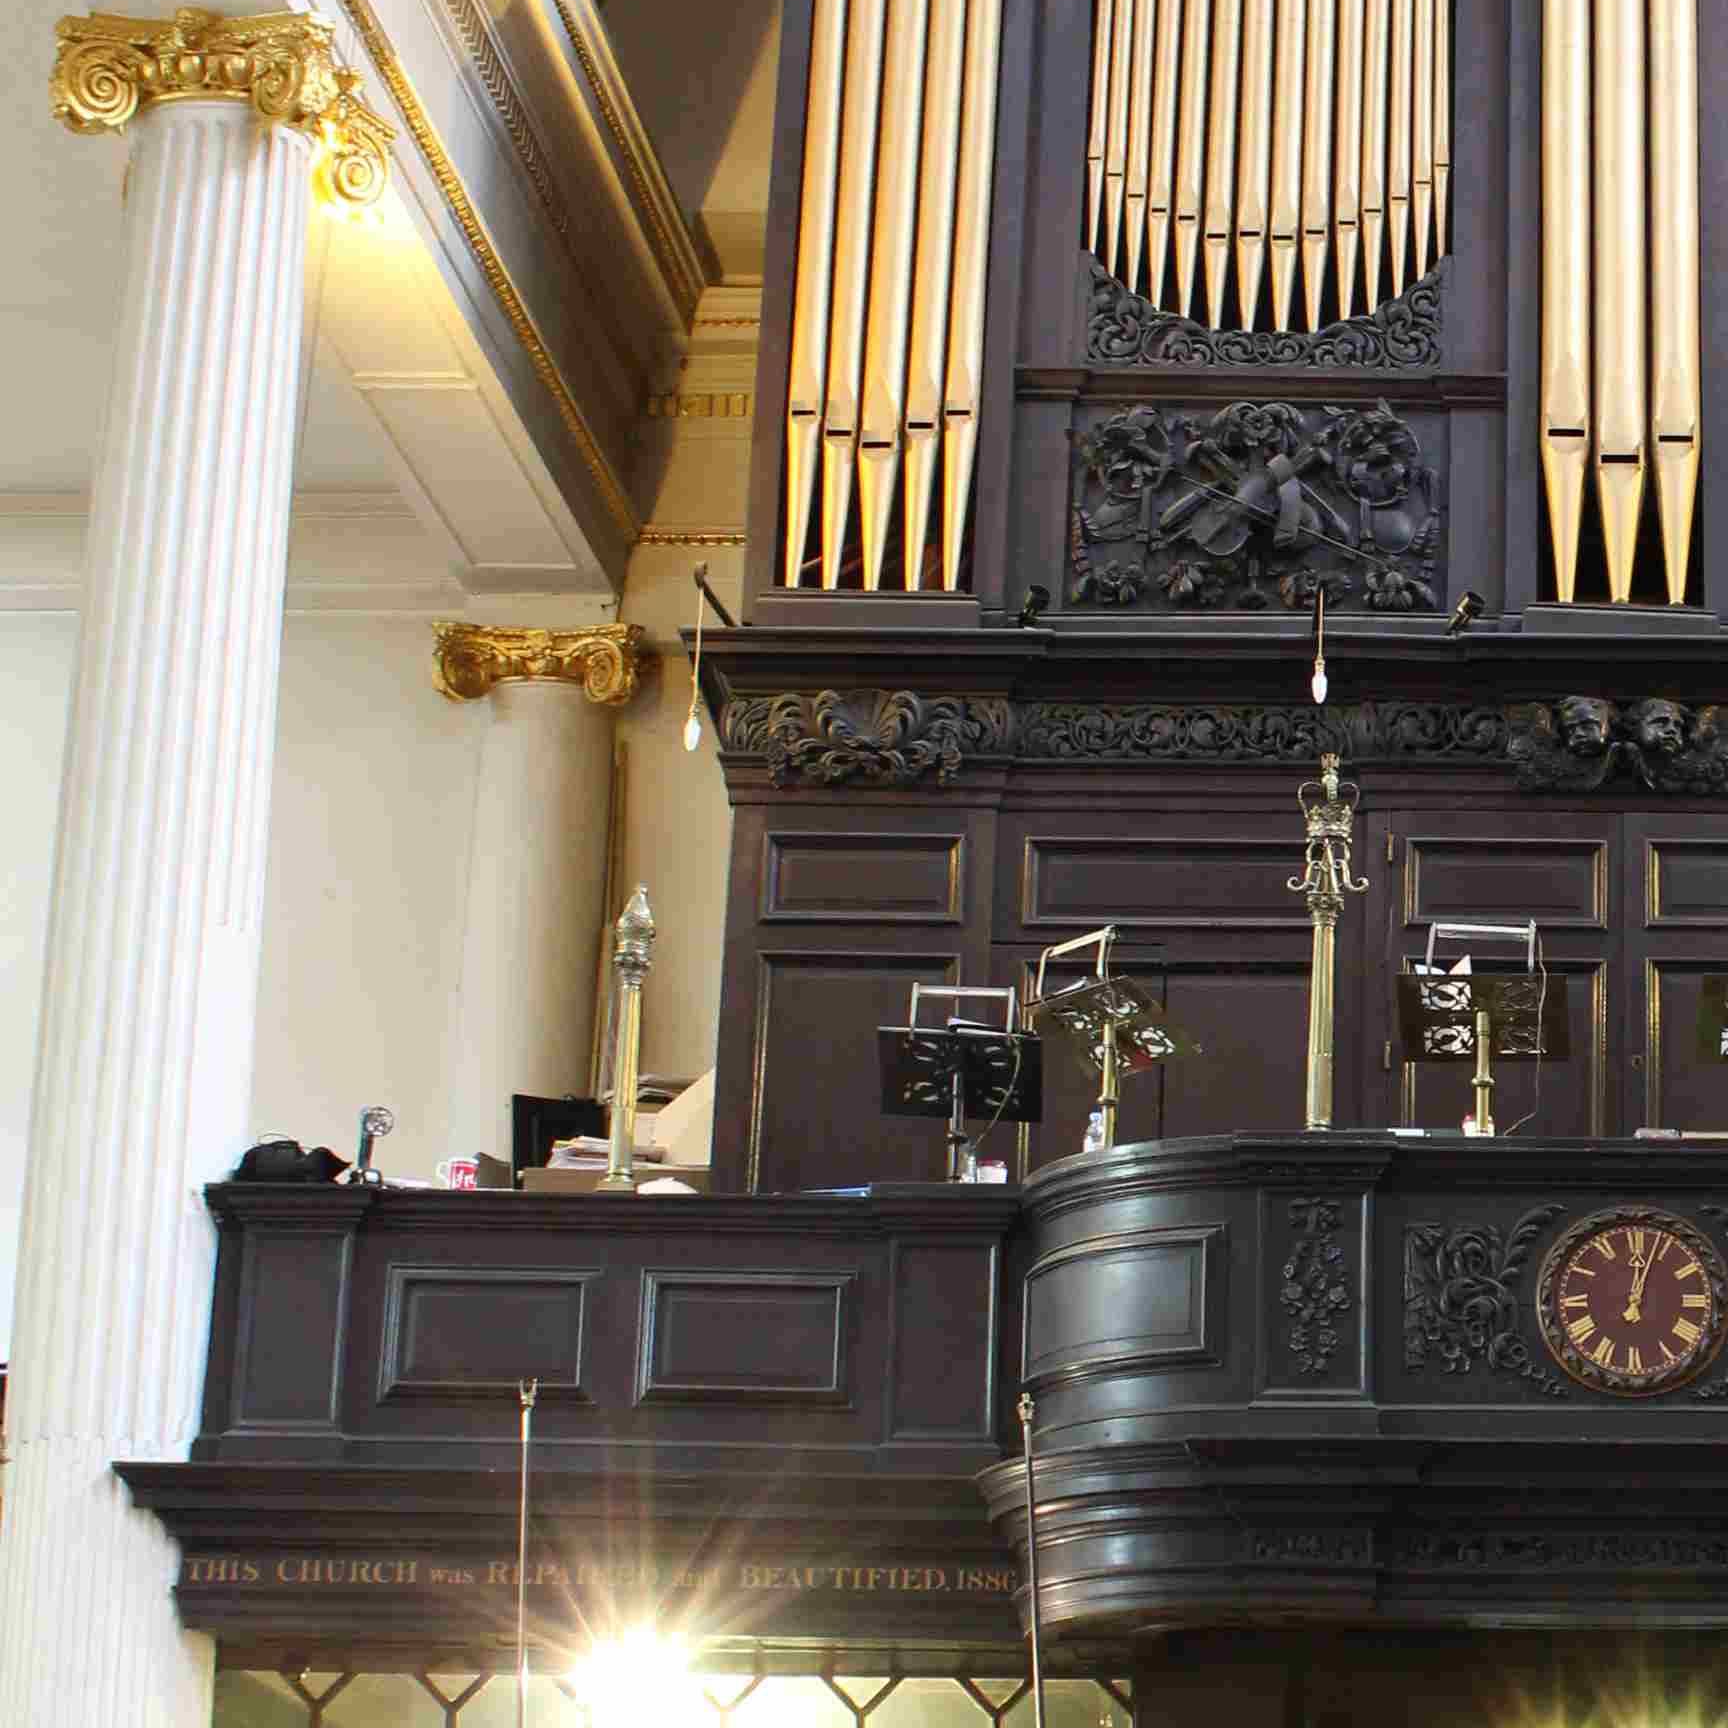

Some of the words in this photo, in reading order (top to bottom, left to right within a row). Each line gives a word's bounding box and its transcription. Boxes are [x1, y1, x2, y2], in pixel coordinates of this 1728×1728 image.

[1673, 1261, 1700, 1280] II
[1681, 1294, 1706, 1307] III
[186, 1558, 259, 1584] THIS
[275, 1559, 417, 1585] CHURCH
[431, 1567, 475, 1585] was
